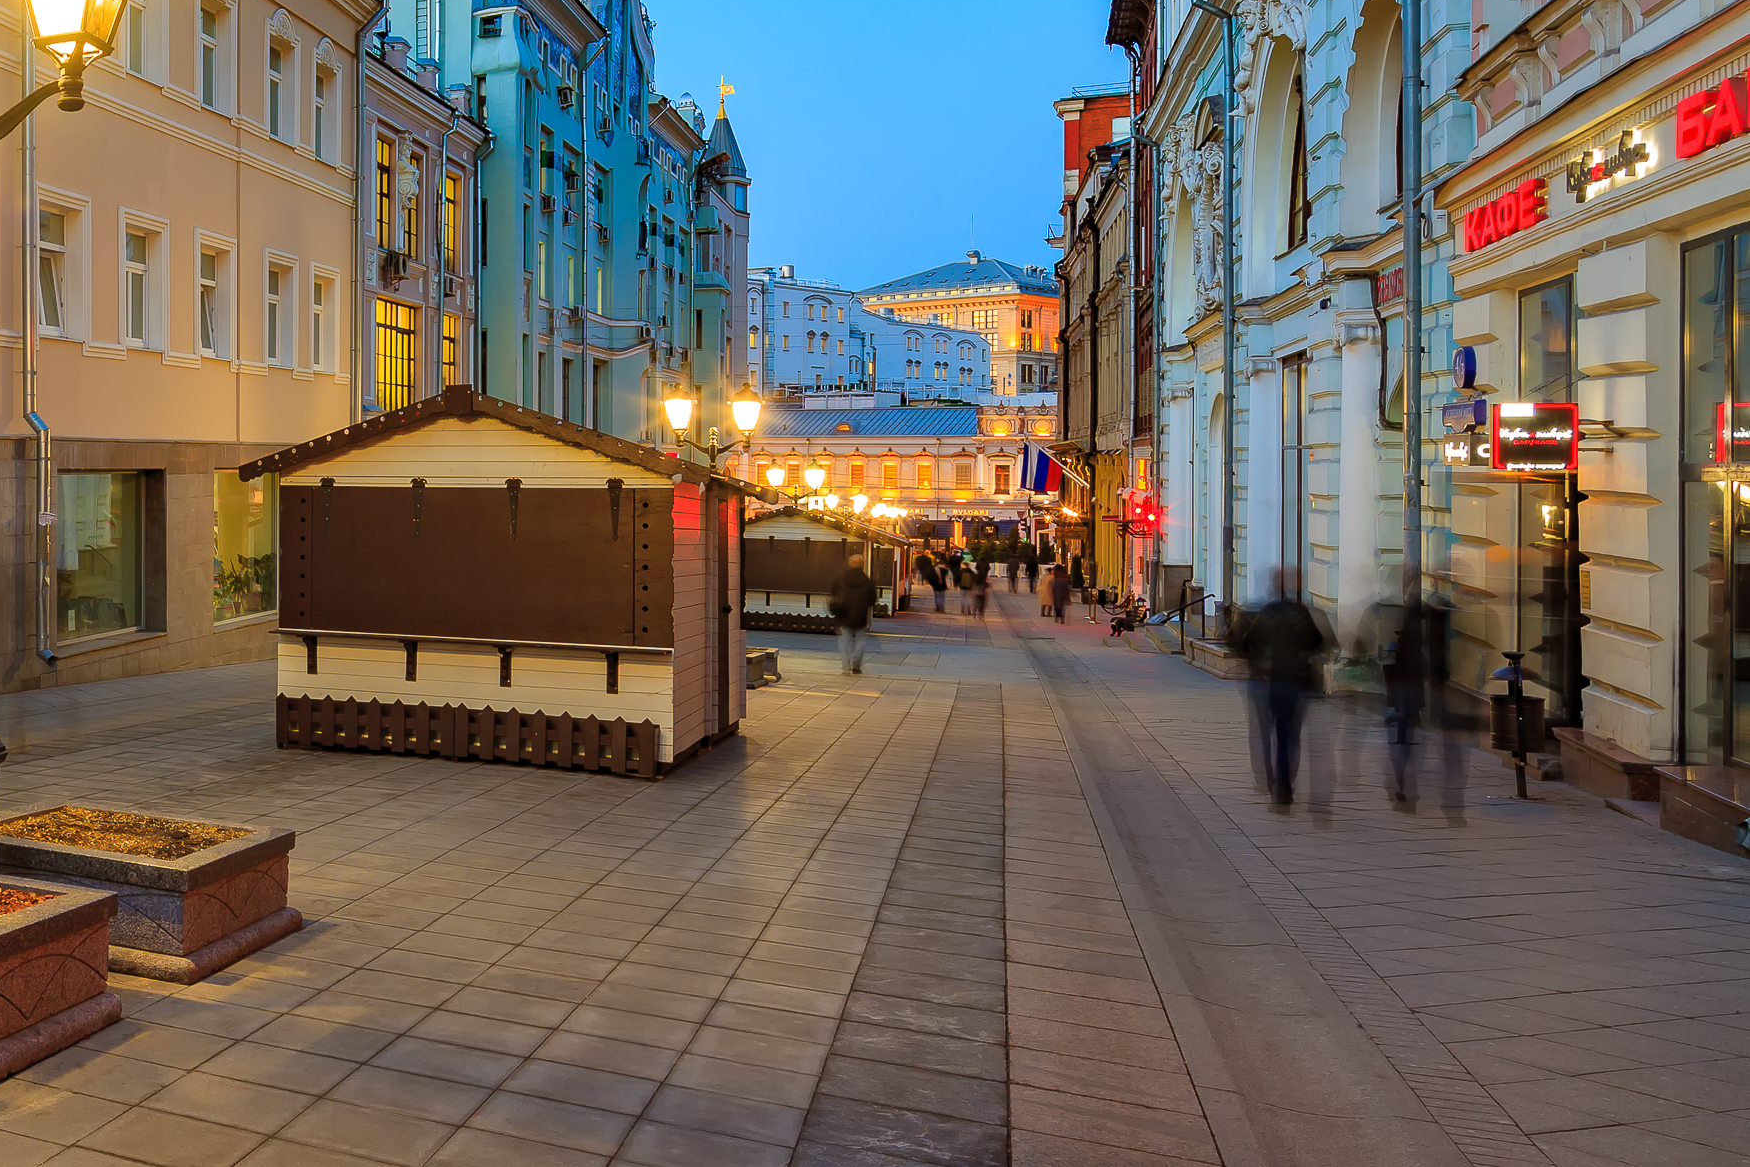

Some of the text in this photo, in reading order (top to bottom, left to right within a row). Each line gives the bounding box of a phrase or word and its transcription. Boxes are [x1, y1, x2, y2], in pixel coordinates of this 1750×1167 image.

[1675, 66, 1750, 159] БА
[1464, 177, 1547, 253] КАФЕ
[952, 508, 989, 516] BVLGARI
